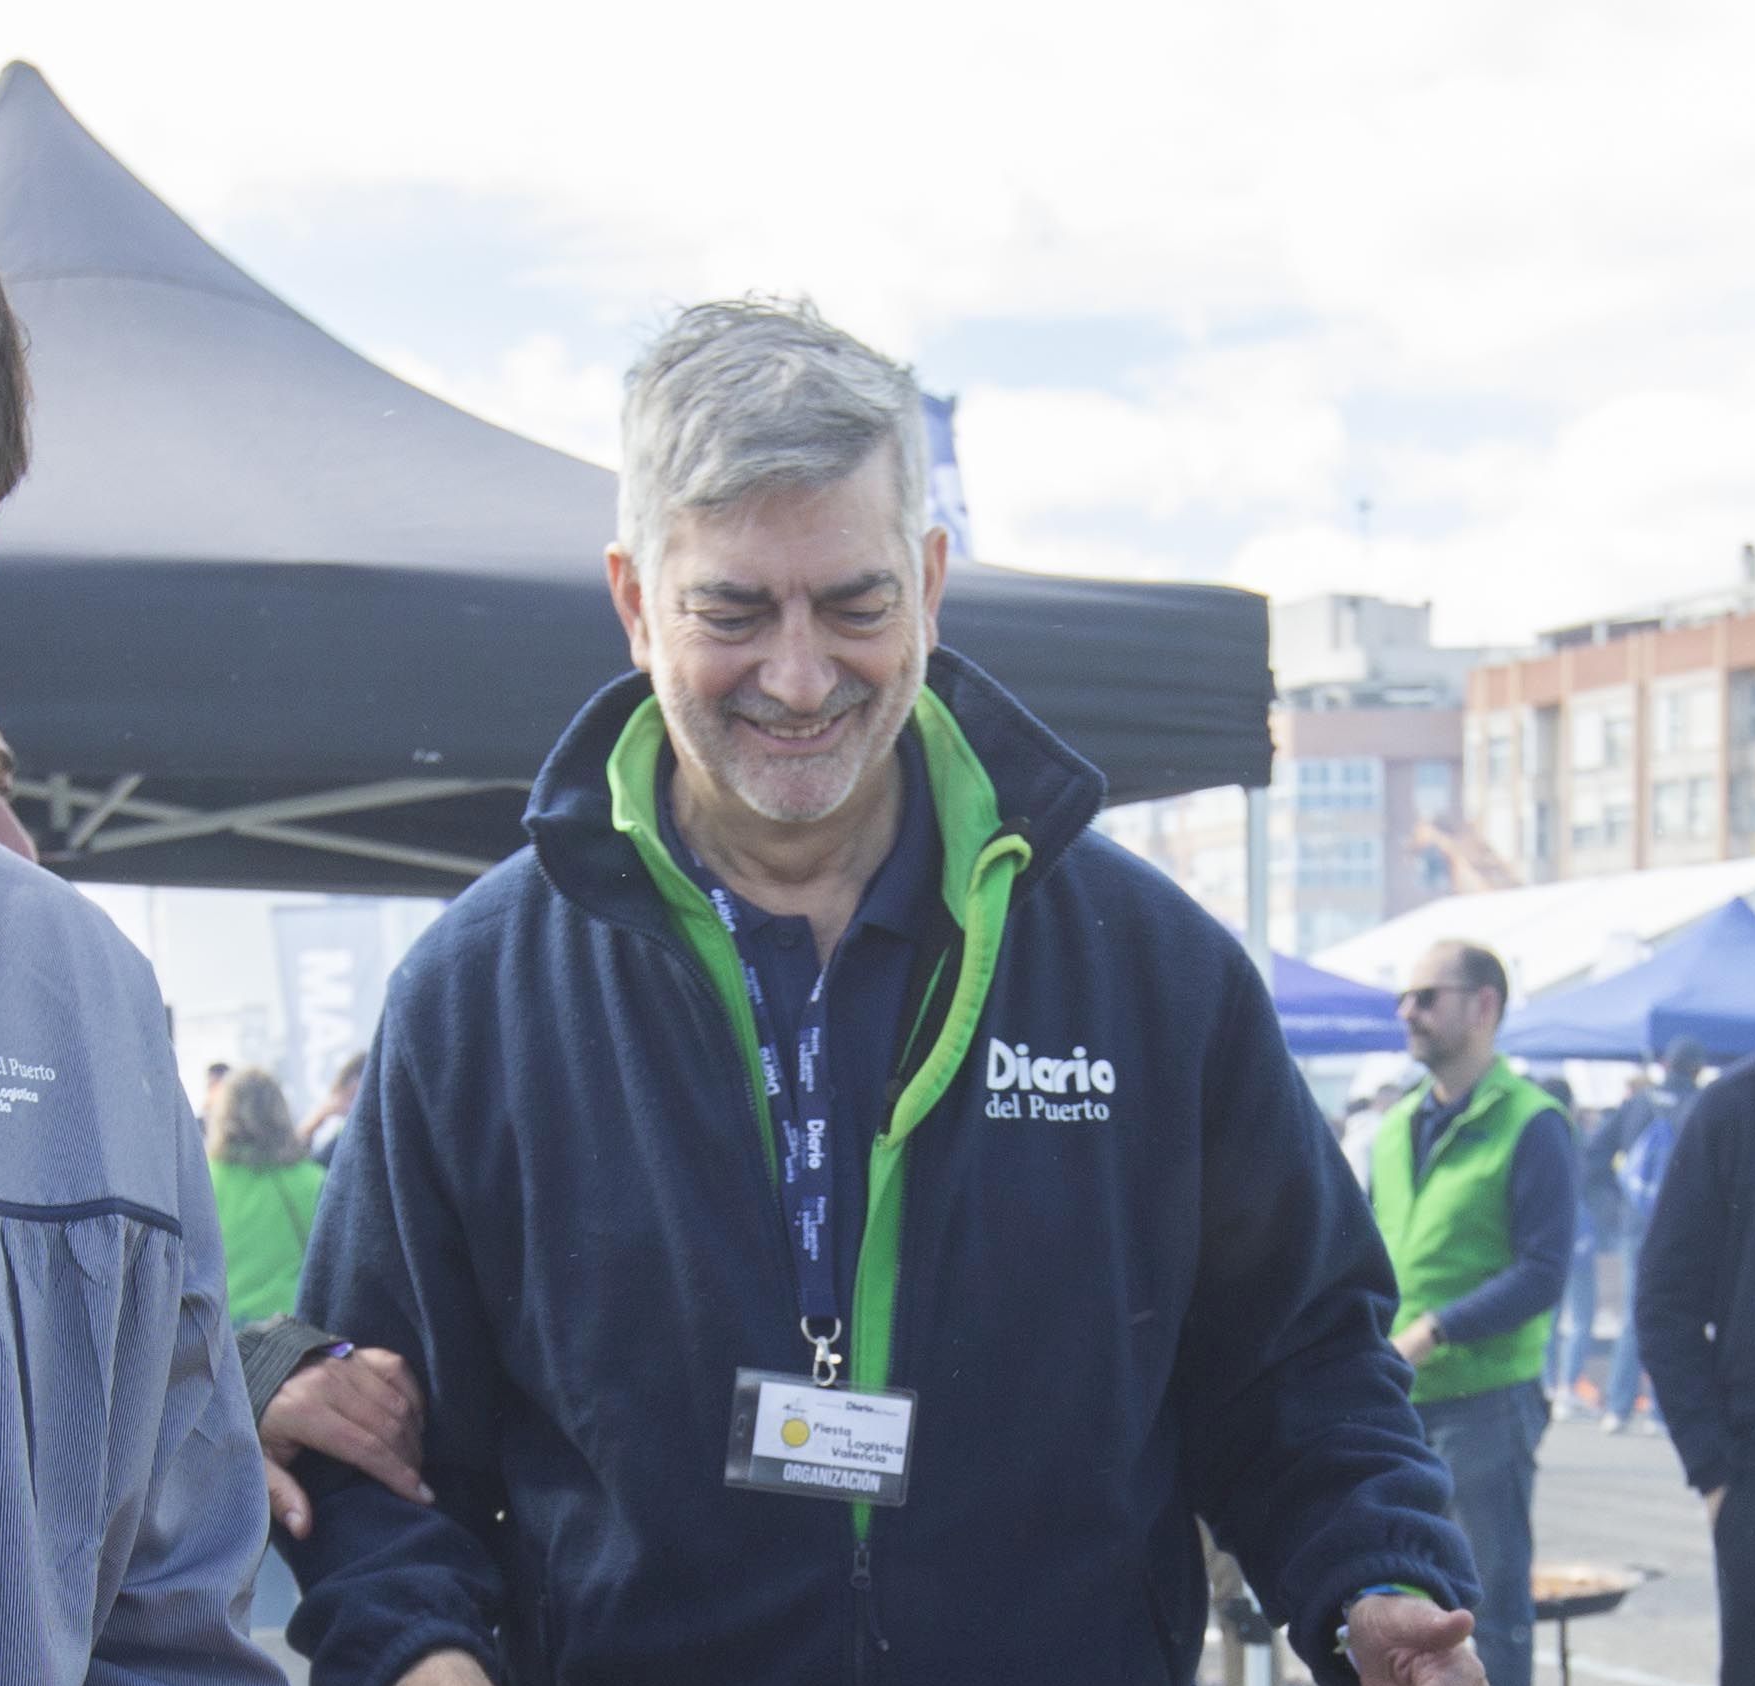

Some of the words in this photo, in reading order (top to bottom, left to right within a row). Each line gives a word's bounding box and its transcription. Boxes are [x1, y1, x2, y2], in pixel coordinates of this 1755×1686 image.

[8, 1058, 55, 1081] Puerto
[986, 1037, 1116, 1094] Diario
[985, 1093, 1021, 1119] del
[1028, 1094, 1110, 1121] Puerto
[807, 1119, 826, 1169] Diario
[813, 1422, 852, 1436] Fiesta
[831, 1447, 887, 1464] Valencia
[782, 1462, 881, 1493] ORGANIZACIÓN
